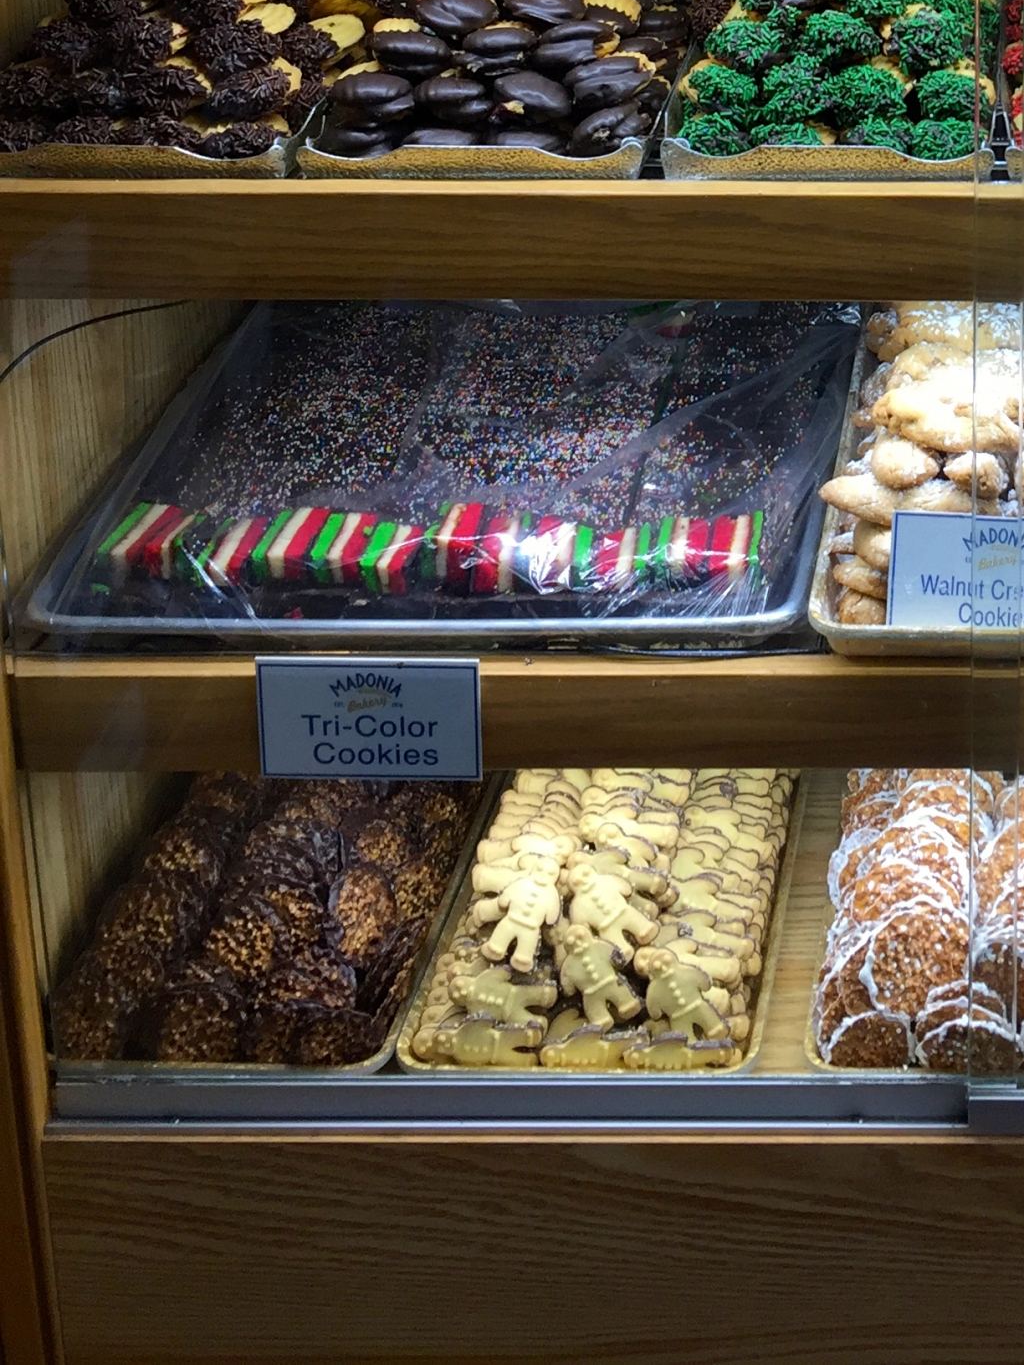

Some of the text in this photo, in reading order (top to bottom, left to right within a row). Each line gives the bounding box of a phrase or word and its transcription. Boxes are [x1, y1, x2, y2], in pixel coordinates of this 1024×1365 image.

[921, 574, 984, 599] Walnut
[329, 673, 402, 698] MADONIA
[347, 697, 389, 713] Bakery
[301, 715, 438, 738] Tri-Color
[313, 742, 439, 766] Cookies
